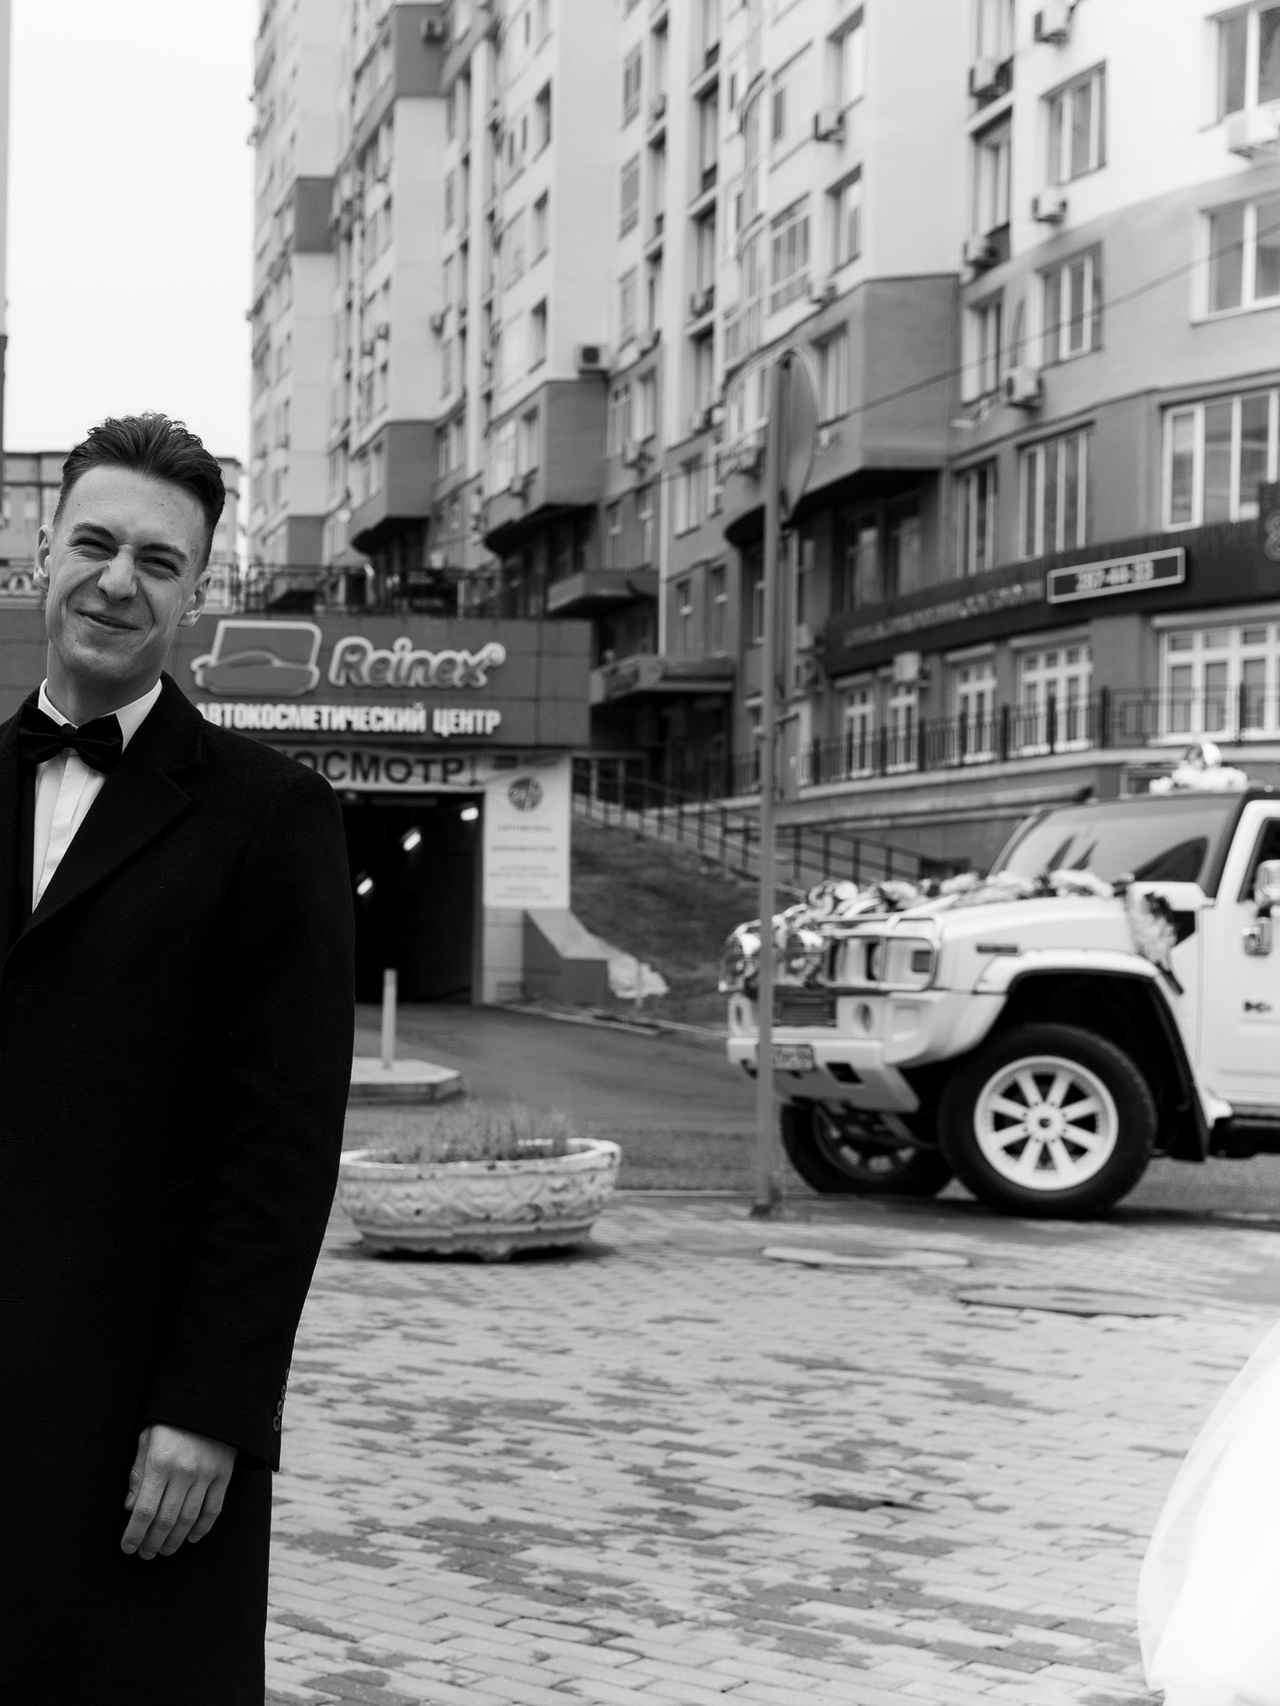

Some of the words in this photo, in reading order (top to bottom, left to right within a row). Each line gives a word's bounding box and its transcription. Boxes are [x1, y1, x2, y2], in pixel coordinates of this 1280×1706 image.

[328, 636, 507, 687] Reinex
[196, 702, 427, 732] АВТОКОСМЕТИЧЕСКИЙ
[433, 707, 501, 737] ЦЕНТР
[291, 750, 464, 785] ОСМОТР
